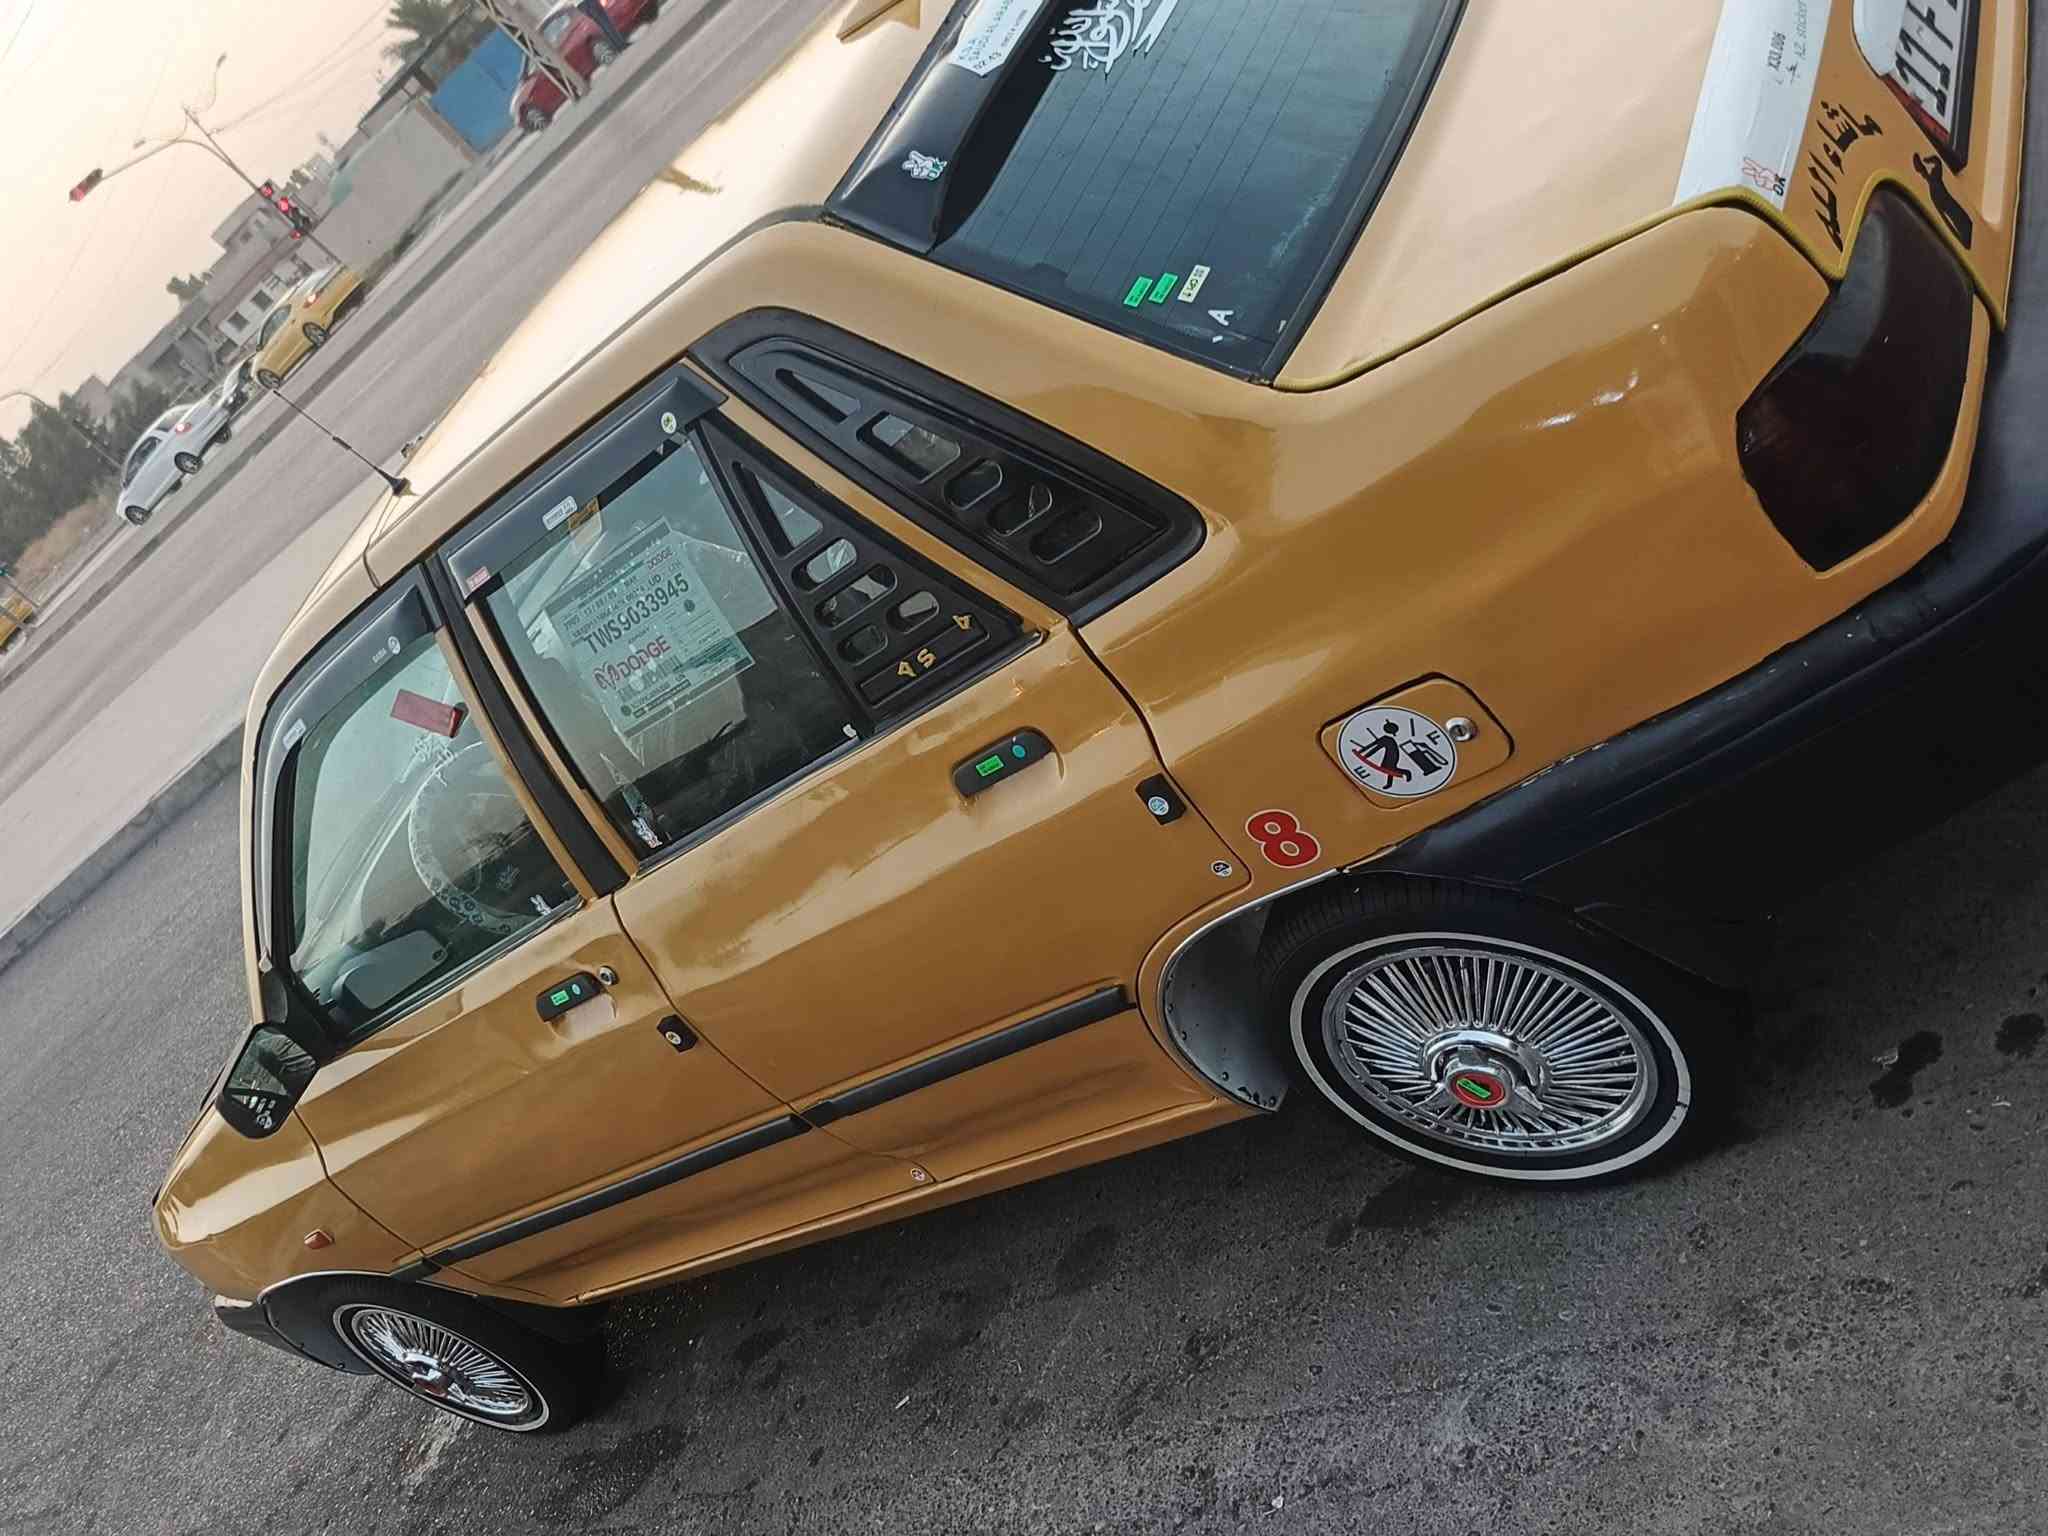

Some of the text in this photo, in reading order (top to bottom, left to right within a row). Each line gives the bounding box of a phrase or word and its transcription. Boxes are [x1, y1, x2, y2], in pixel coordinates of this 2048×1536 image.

[583, 572, 689, 655] TWS9033945
[617, 634, 672, 677] DODGE
[1244, 808, 1321, 869] 8
